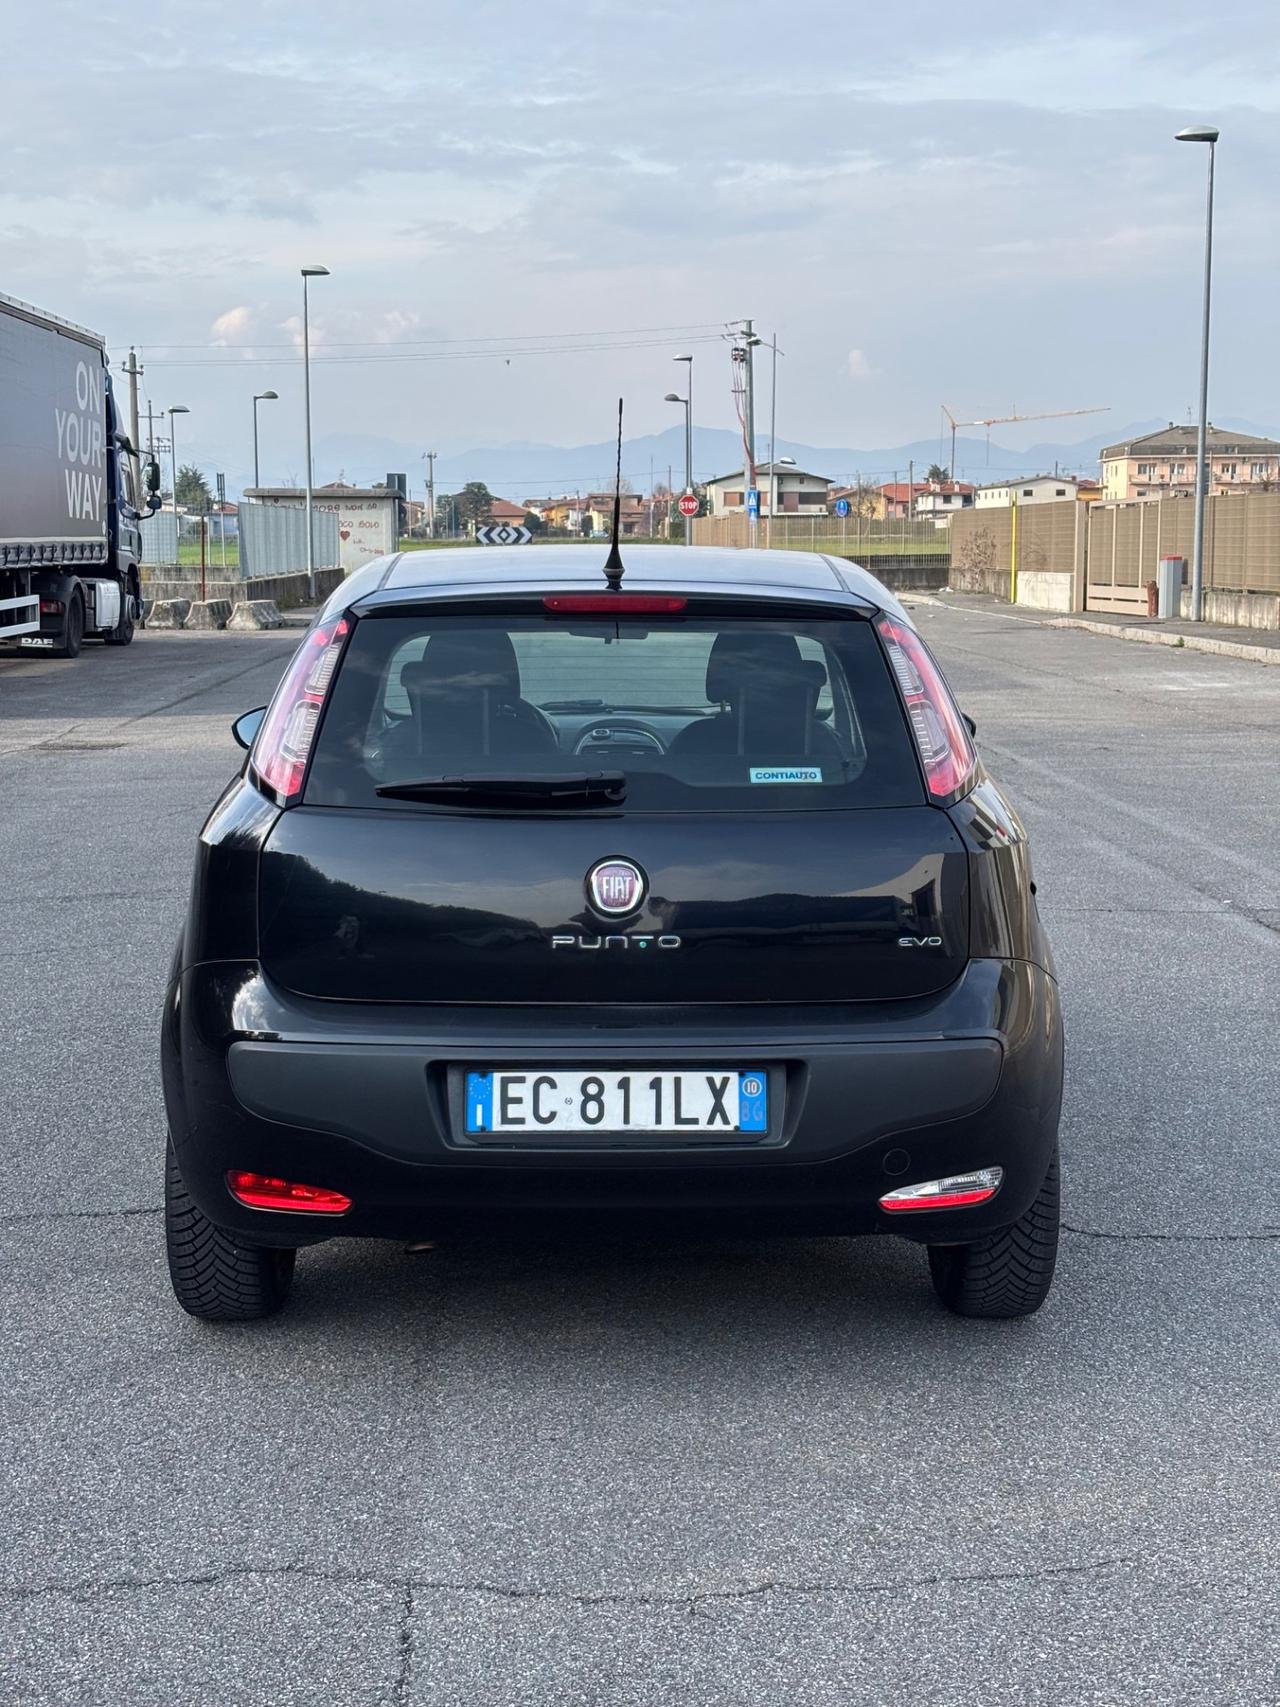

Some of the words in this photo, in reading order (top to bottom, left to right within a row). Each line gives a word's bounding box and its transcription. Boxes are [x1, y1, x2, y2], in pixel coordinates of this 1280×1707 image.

[76, 361, 100, 414] ON
[55, 408, 101, 468] YOUR
[65, 469, 102, 522] WAY
[680, 501, 698, 510] STOP
[21, 637, 54, 645] DAF
[755, 771, 818, 780] CONTIAUTO
[602, 876, 632, 902] FIAT
[552, 935, 682, 949] PUNTO
[898, 936, 942, 947] EVO
[476, 1104, 483, 1126] I
